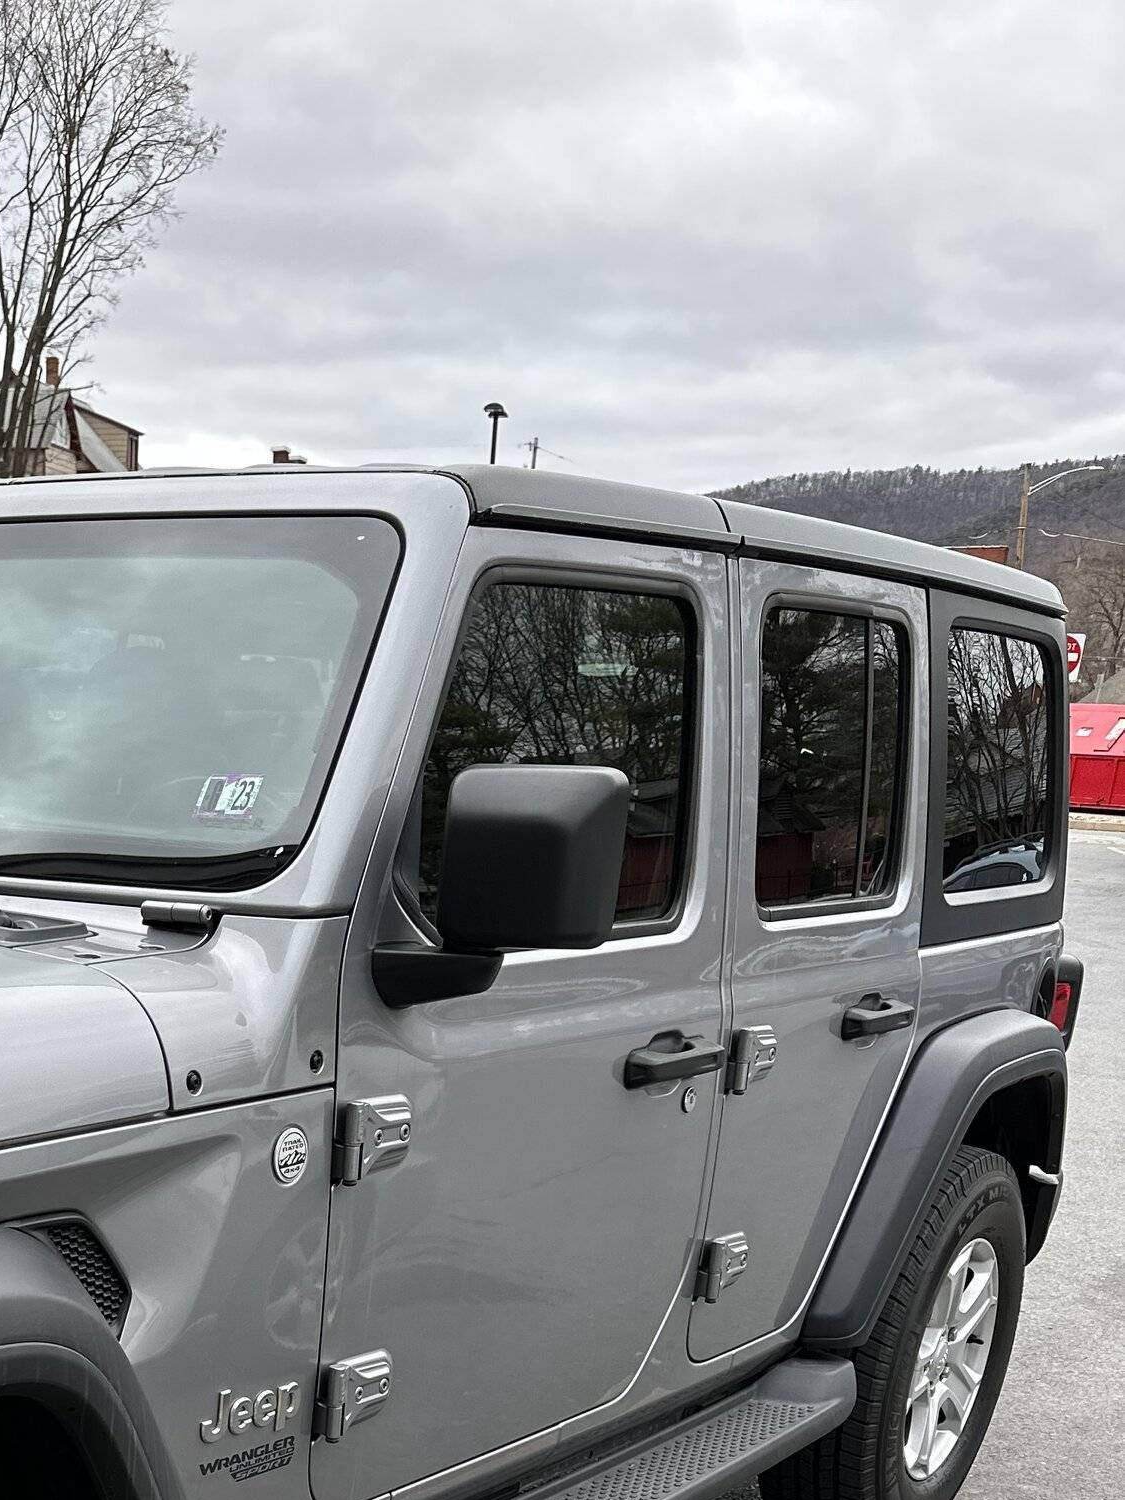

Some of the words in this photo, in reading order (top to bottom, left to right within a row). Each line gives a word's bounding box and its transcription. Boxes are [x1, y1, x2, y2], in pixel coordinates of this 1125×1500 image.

[231, 780, 256, 811] 23
[200, 1382, 299, 1443] Jeep
[199, 1436, 295, 1476] WRANGLER
[229, 1447, 295, 1472] UNLIMITED
